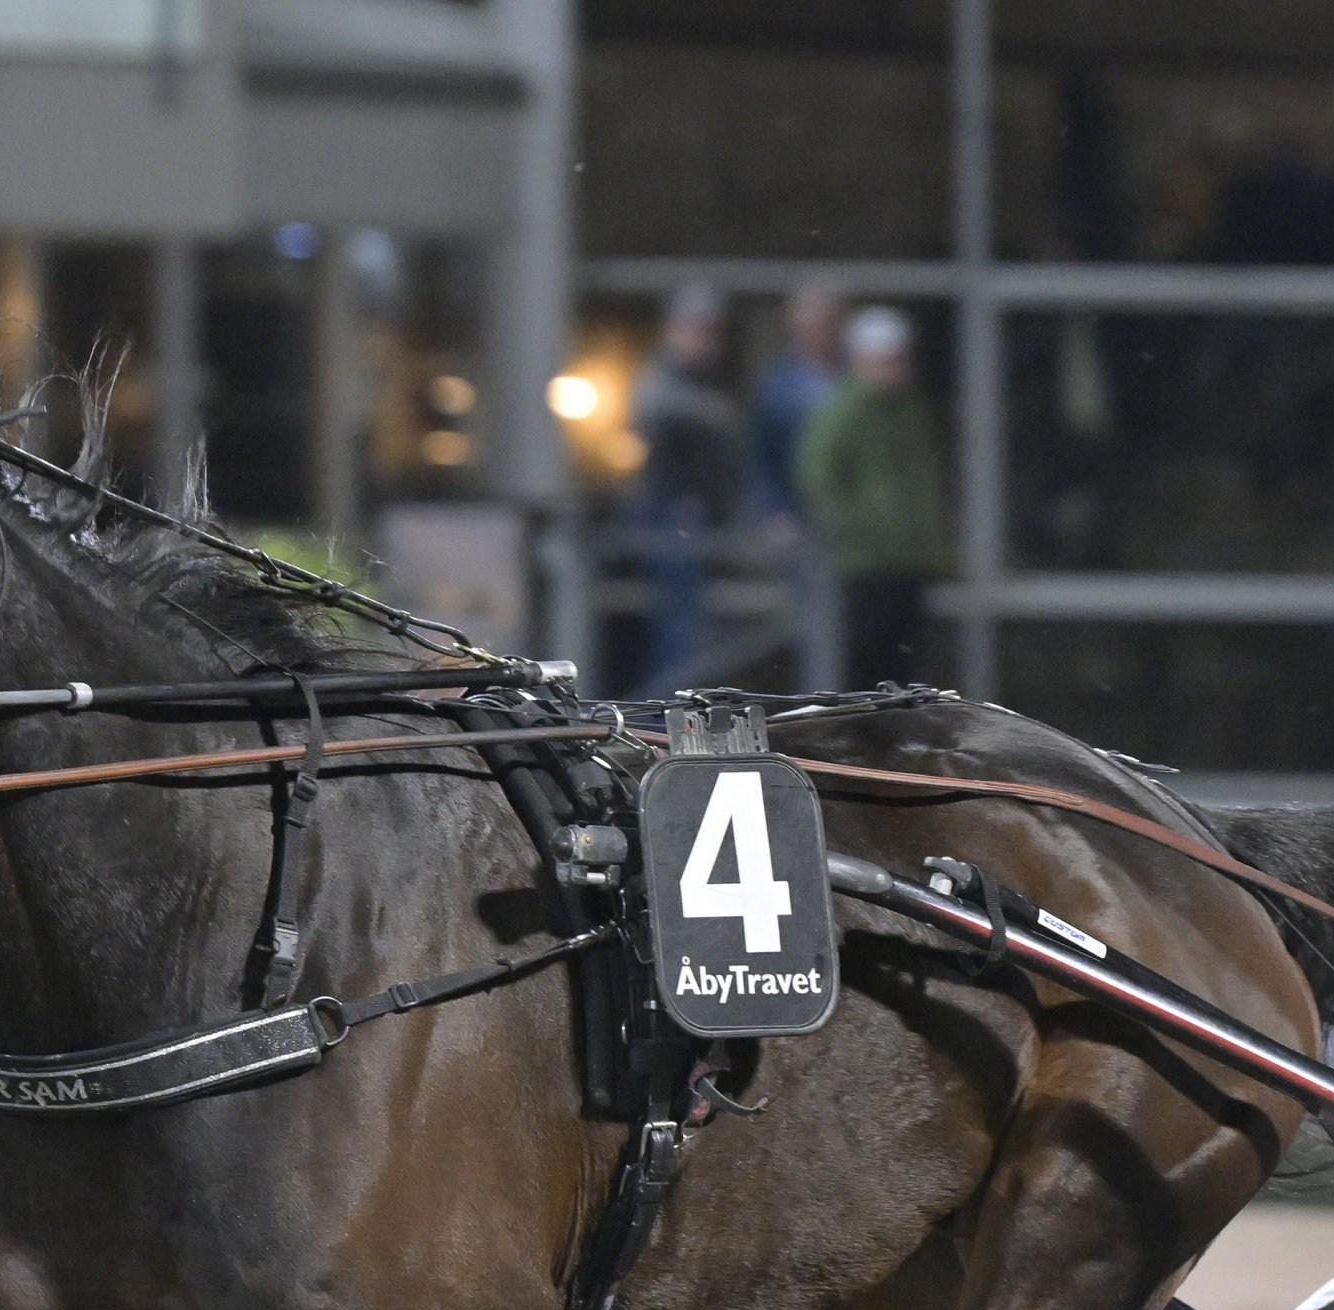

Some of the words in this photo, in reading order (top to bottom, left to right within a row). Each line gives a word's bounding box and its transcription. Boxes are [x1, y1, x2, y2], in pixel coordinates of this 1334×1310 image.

[679, 772, 792, 953] 4
[675, 956, 821, 1004] ÅbyTravet
[18, 1078, 88, 1108] SAM
